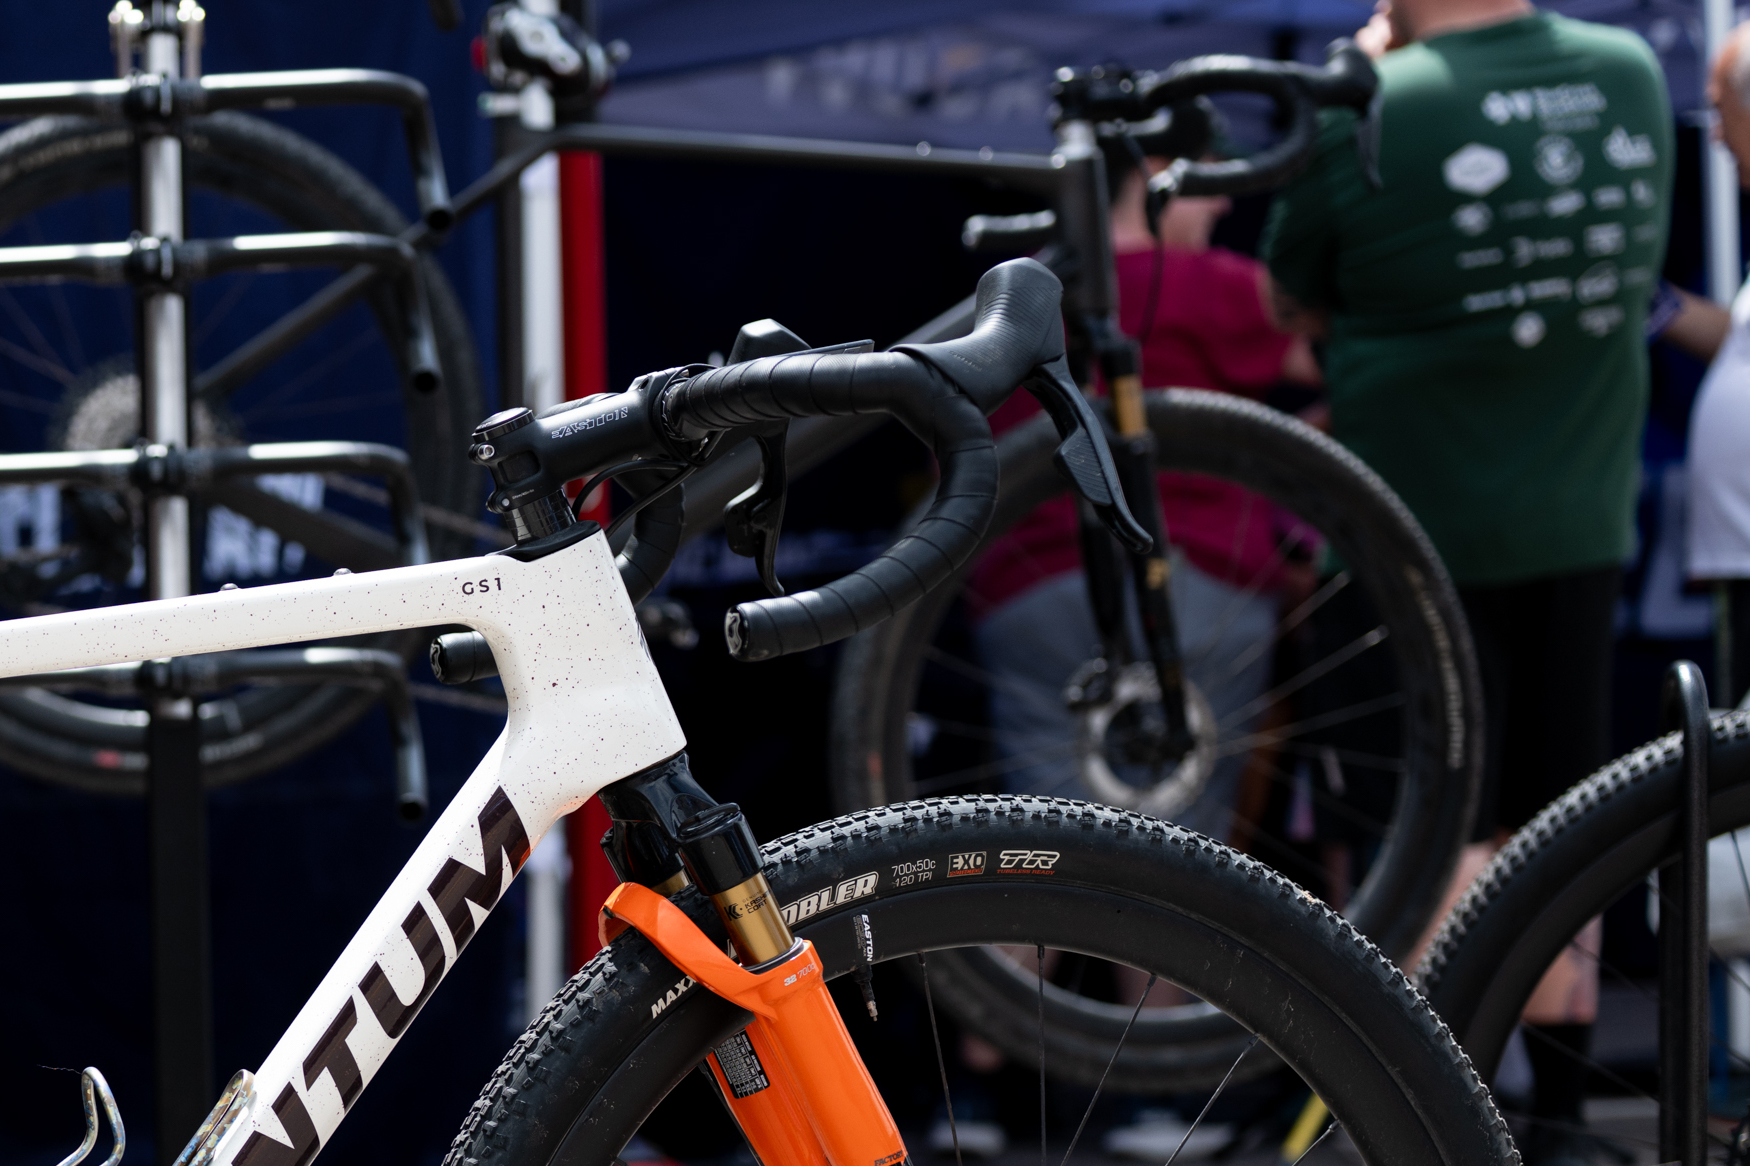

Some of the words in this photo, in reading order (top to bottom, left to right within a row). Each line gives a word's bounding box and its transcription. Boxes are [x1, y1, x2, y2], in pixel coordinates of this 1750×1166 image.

[891, 859, 936, 878] 700x50c
[949, 853, 986, 870] EXO
[999, 850, 1060, 869] TR
[894, 874, 915, 888] 120
[917, 871, 933, 884] TPI
[861, 914, 873, 962] EASTON
[650, 975, 697, 1020] MAXX
